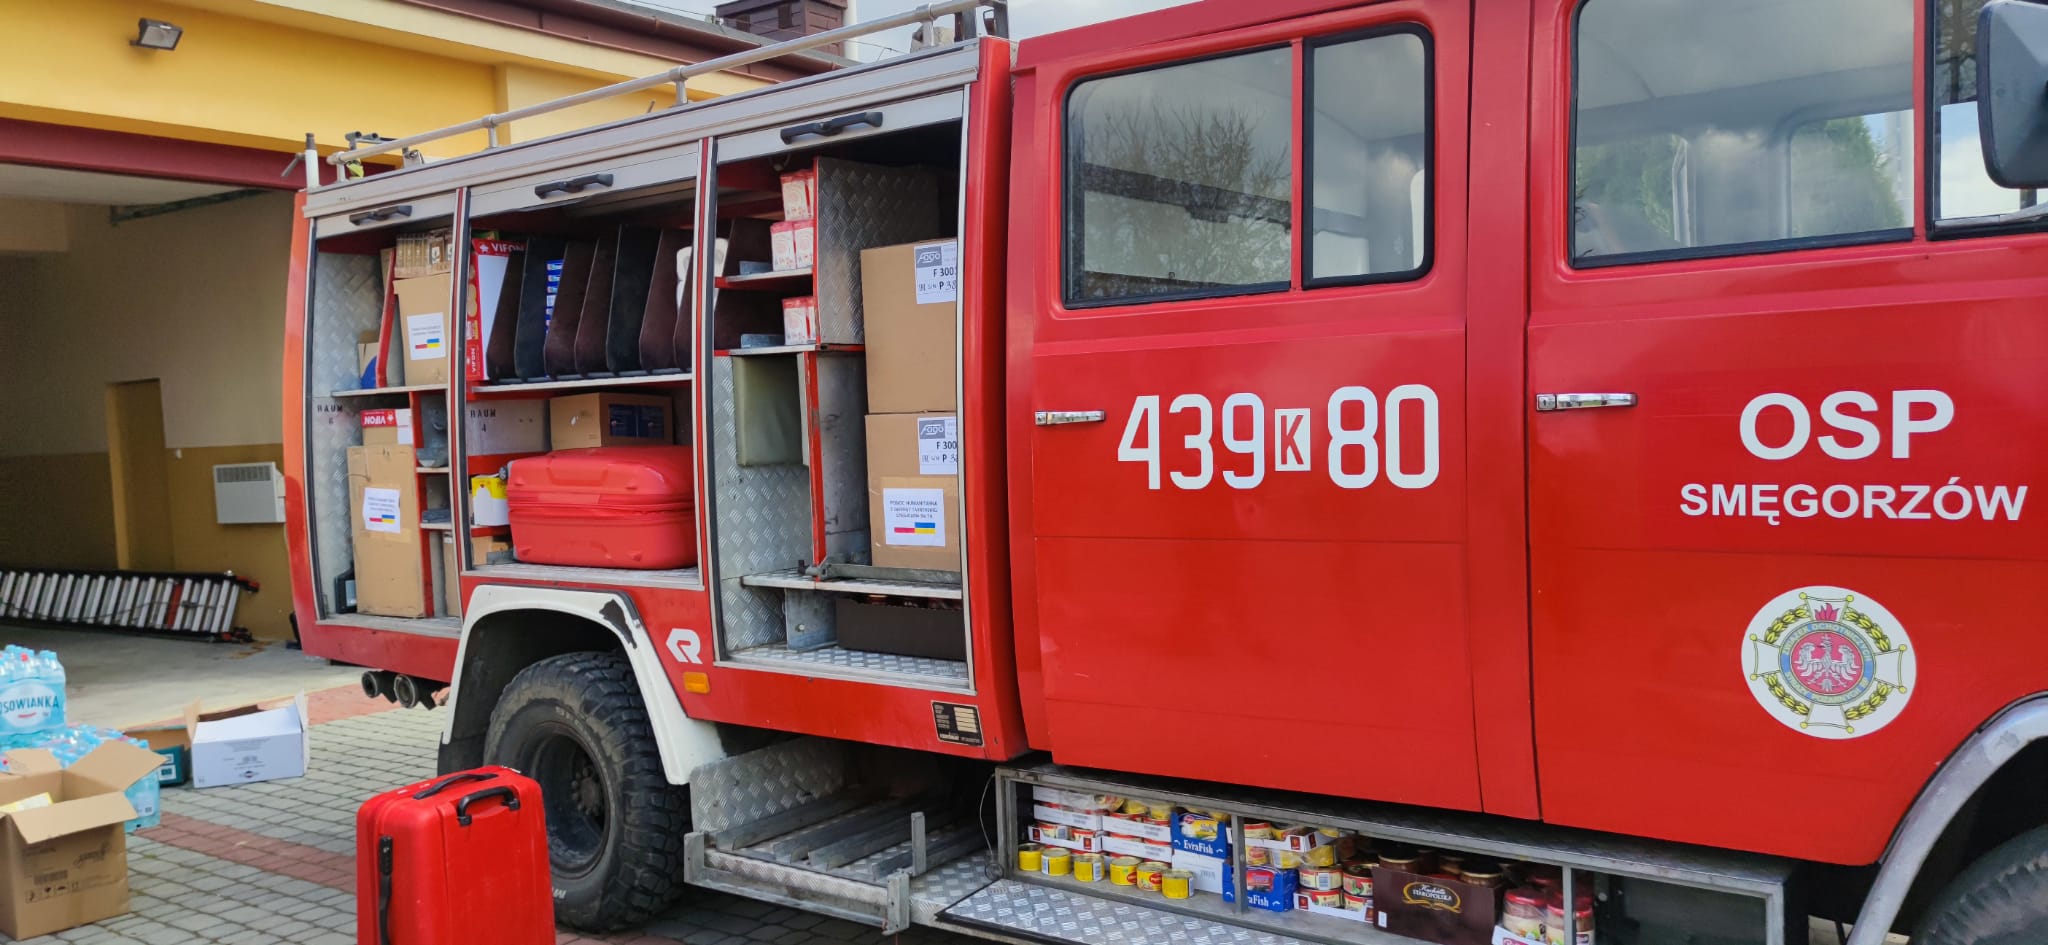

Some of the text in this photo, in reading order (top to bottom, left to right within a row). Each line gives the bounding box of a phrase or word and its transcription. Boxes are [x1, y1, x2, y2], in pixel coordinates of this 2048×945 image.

[940, 266, 956, 277] 300
[1117, 384, 1440, 490] 439 K 80
[1739, 389, 1955, 460] OSP
[1680, 476, 2028, 526] SMĘGORZÓW
[1183, 839, 1214, 855] EvraFish
[1247, 894, 1269, 907] aFish
